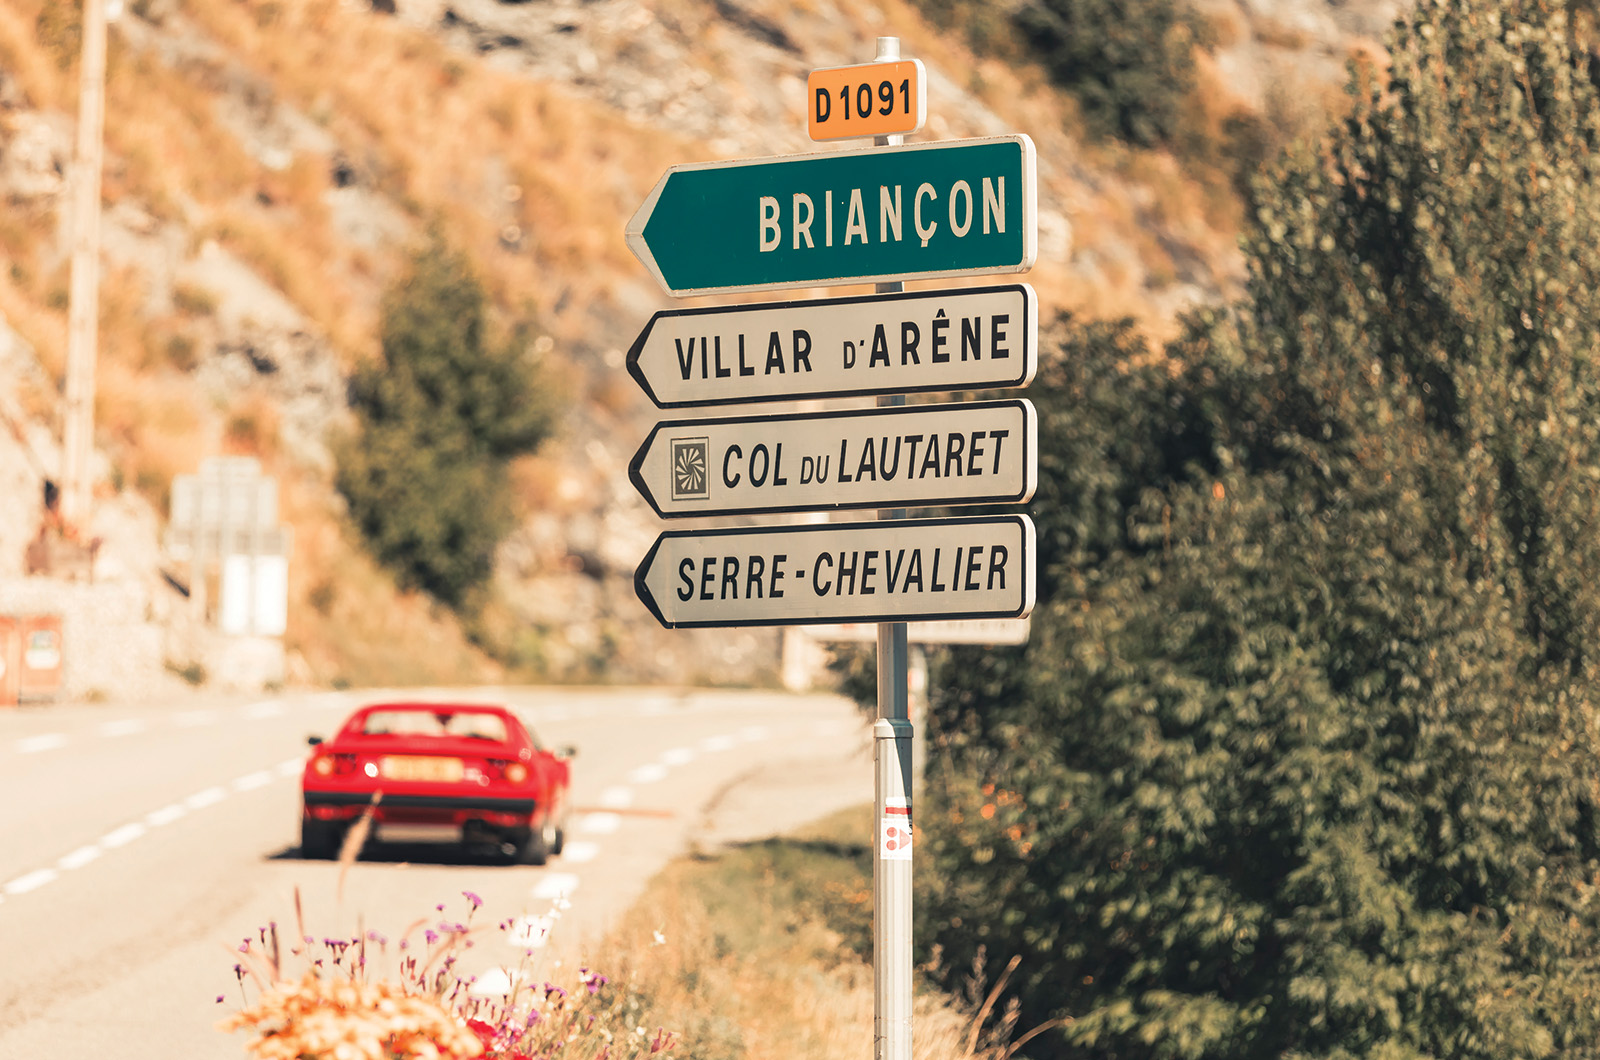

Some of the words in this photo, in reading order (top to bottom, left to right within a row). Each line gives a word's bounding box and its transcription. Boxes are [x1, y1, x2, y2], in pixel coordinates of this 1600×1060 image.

[759, 176, 1006, 253] BRIANÇON
[674, 329, 813, 380] VILLAR
[722, 442, 788, 488] COL
[800, 455, 830, 485] DU
[837, 429, 1010, 483] LAUTARET
